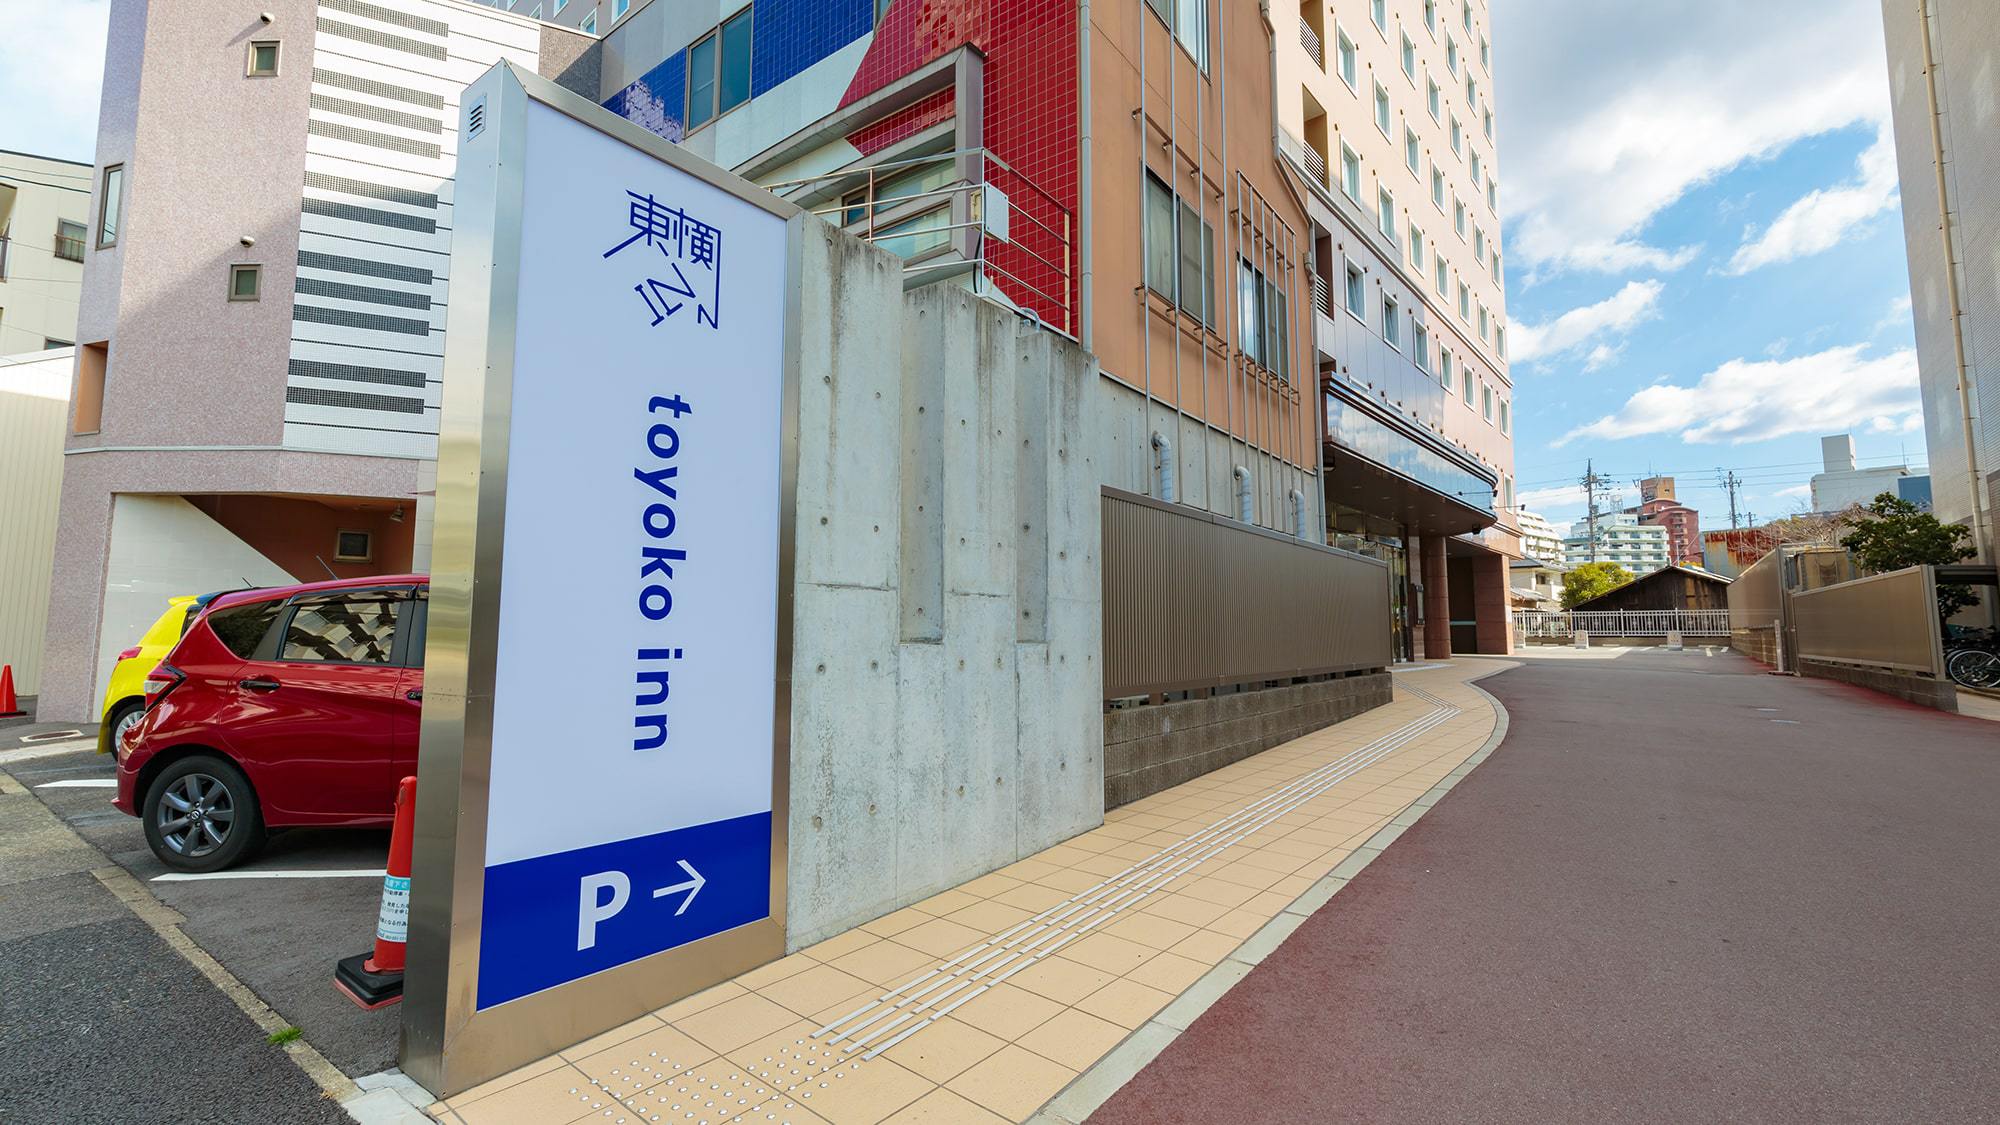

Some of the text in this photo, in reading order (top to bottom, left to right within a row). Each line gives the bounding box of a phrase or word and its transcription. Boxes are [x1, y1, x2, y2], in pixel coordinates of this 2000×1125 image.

[633, 394, 693, 751] toyoko inn
[577, 870, 631, 952] P
